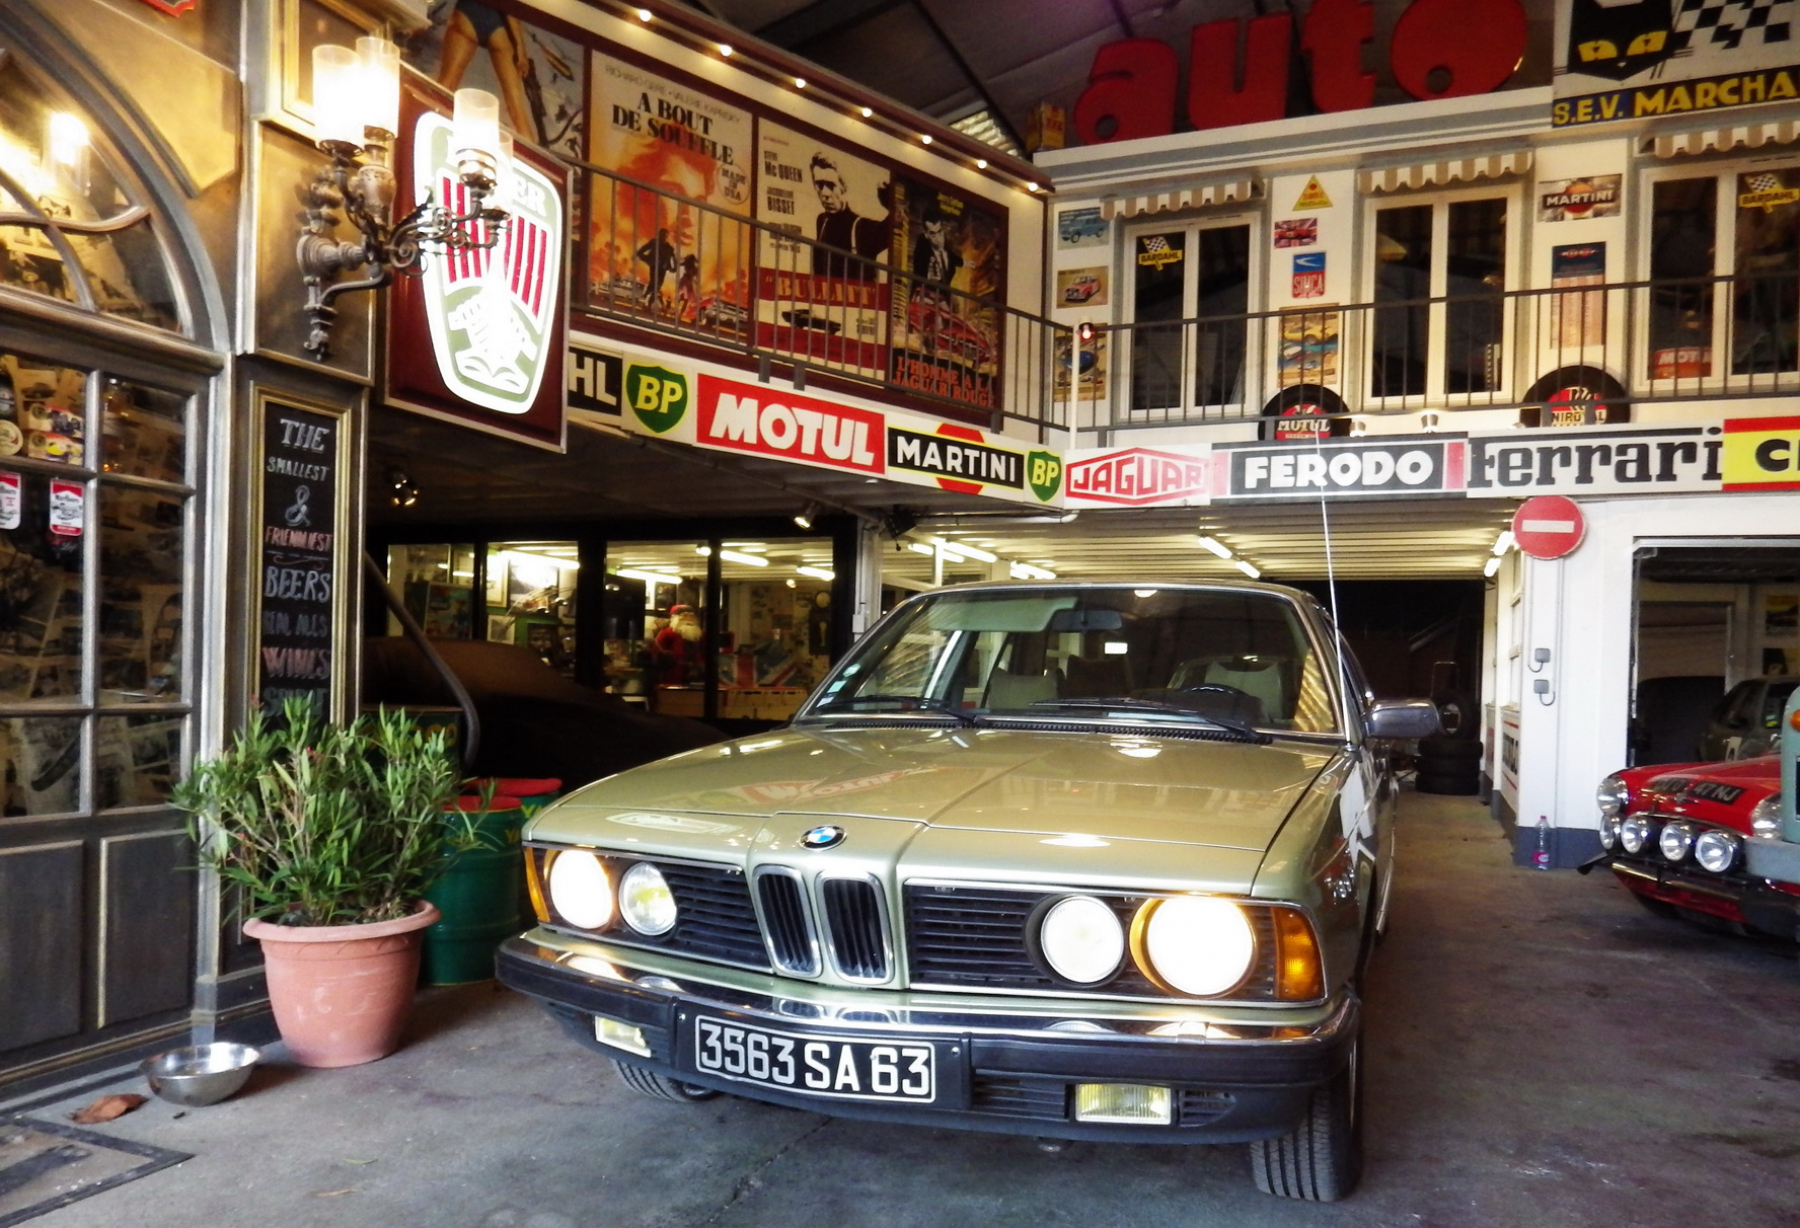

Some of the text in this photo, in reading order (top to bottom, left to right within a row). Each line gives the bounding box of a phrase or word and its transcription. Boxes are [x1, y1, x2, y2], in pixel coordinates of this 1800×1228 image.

[1073, 0, 1528, 146] auto
[637, 92, 714, 136] A BOUT
[1552, 71, 1800, 126] S.E.V. MARCHA
[611, 104, 734, 166] DE SOUFFLE
[723, 185, 742, 201] USA
[1546, 188, 1614, 207] MARTINI
[1140, 251, 1180, 263] BARDAHL
[635, 374, 683, 414] BP
[280, 418, 330, 453] THE
[709, 392, 875, 466] MOTUL
[1277, 418, 1331, 432] MOTUL
[266, 456, 330, 481] SMALLEST
[897, 436, 1016, 482] MARTINI
[1032, 458, 1059, 487] BP
[1245, 450, 1434, 489] FERODO
[1467, 426, 1723, 489] Ferrari
[1755, 438, 1800, 473] C
[1074, 454, 1201, 497] JAGUAR
[265, 566, 331, 603] BEERS
[700, 1022, 930, 1095] 3563 SA 63
